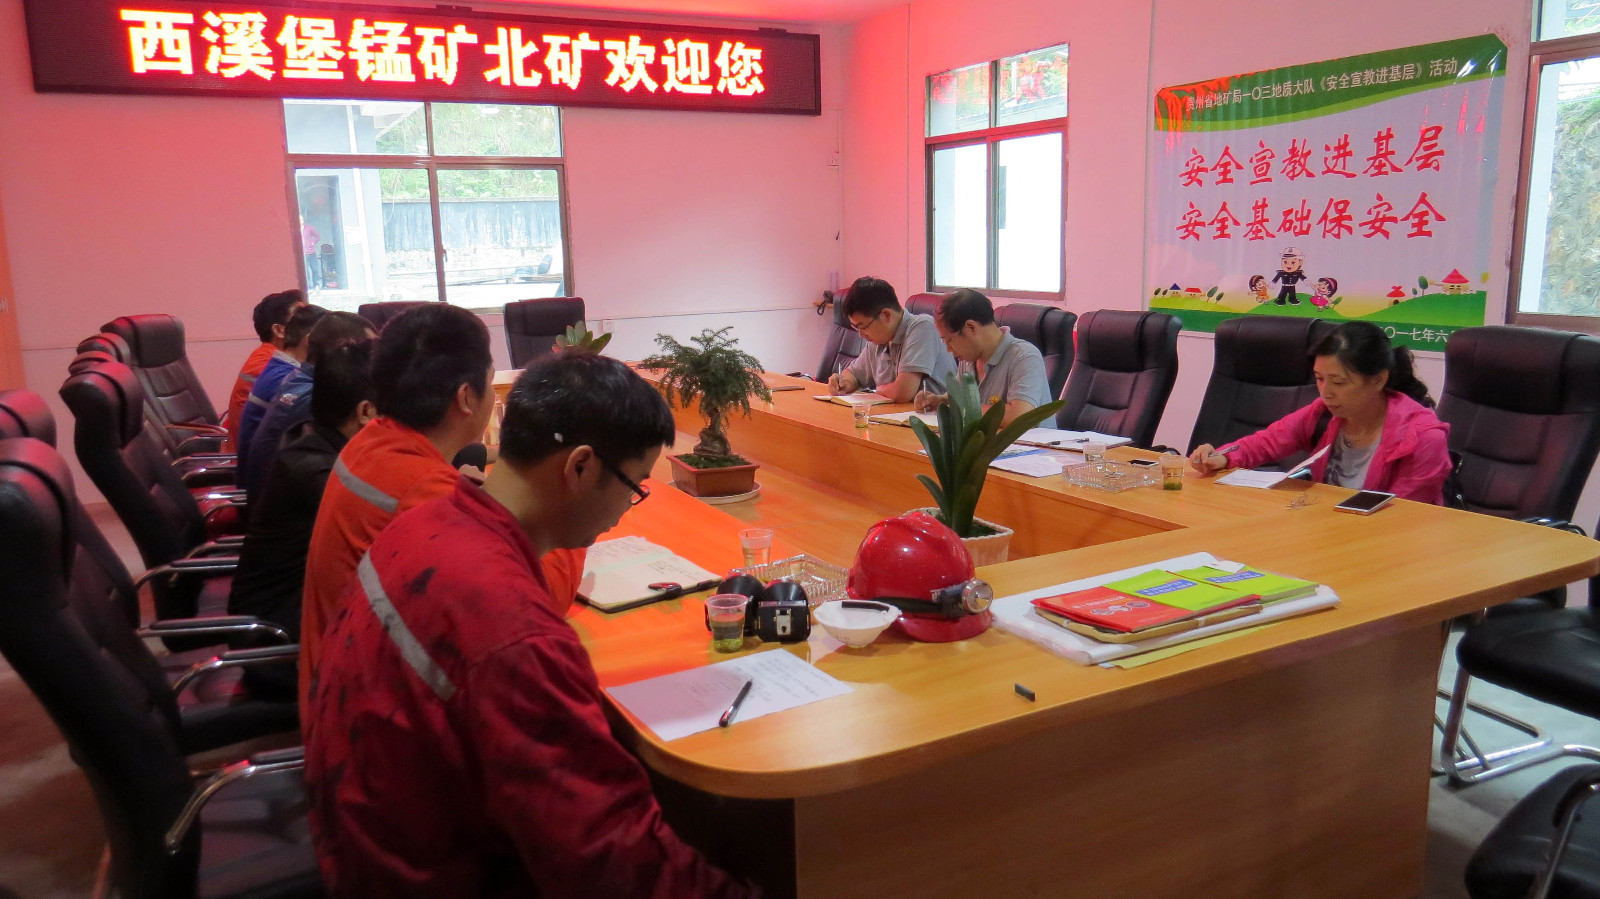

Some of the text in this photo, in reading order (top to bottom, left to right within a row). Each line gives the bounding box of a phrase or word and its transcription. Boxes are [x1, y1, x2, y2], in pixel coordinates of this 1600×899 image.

[121, 9, 765, 95] 西溪堡锰矿北矿欢迎您
[1179, 124, 1446, 188] 安全宣教进基层
[1176, 191, 1447, 241] 安全基础保安全
